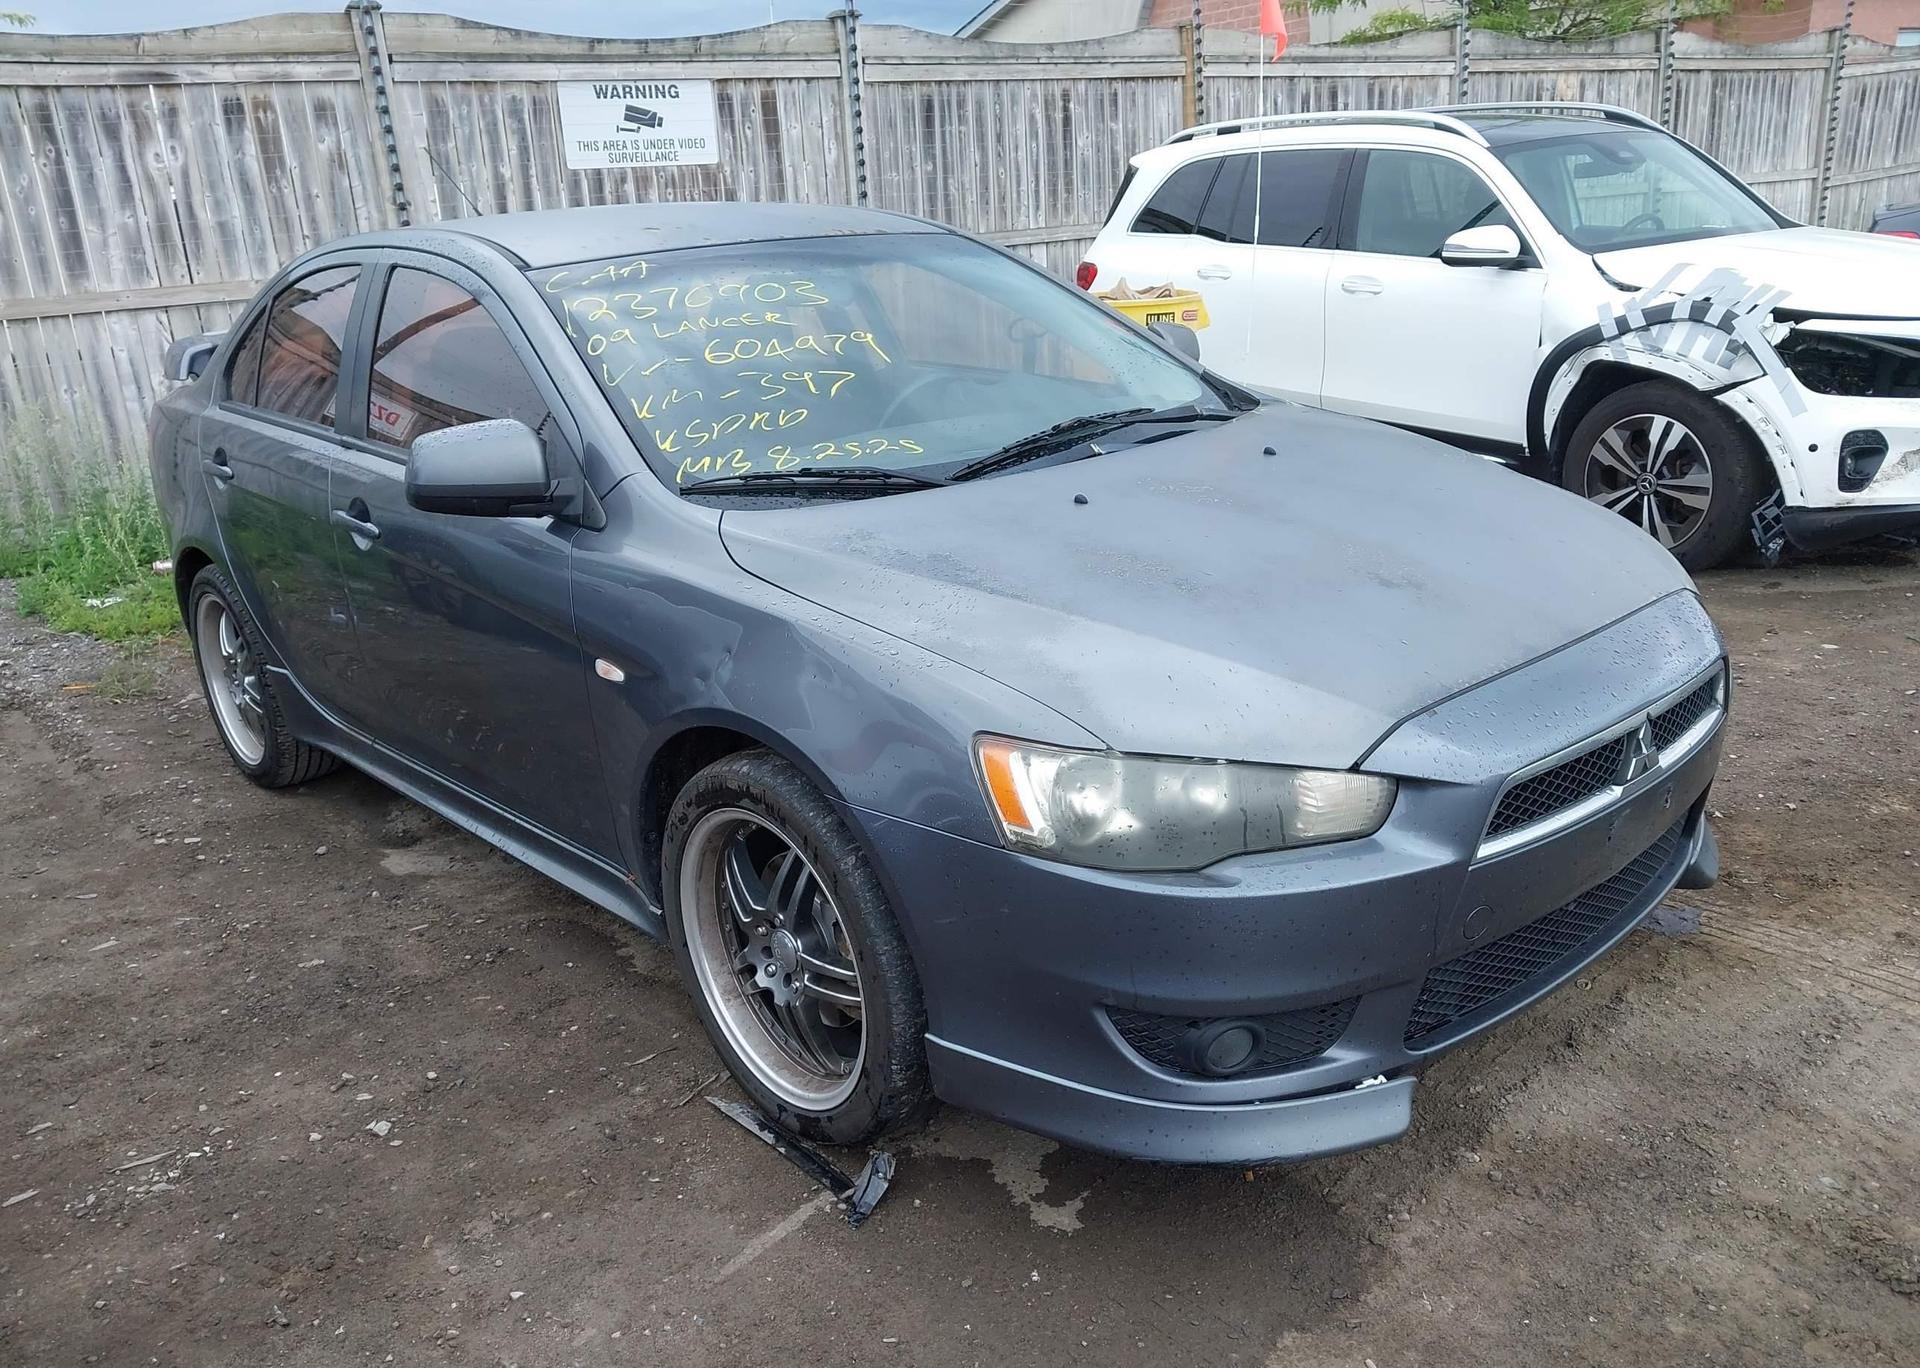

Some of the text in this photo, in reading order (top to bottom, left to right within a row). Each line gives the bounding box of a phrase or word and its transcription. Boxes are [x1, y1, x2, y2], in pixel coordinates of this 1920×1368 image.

[593, 84, 680, 100] WARNING
[576, 138, 706, 152] THIS AREA IS UNDER VIDEO
[608, 150, 680, 164] SURVEILLANCE
[561, 280, 830, 338] 12376903
[587, 312, 799, 356] 09 LANCER
